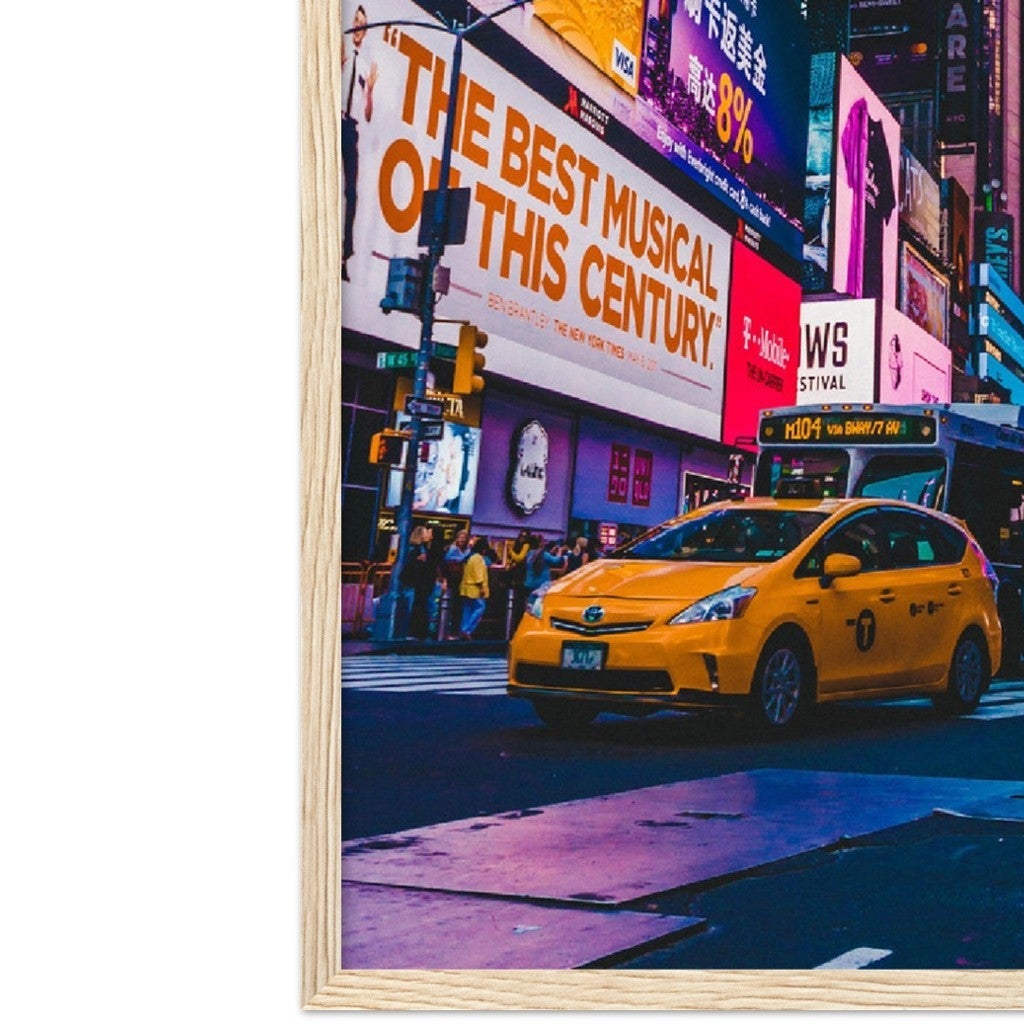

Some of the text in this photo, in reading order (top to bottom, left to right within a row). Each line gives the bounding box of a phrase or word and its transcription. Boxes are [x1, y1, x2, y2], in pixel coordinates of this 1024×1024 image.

[615, 47, 634, 78] VISA
[580, 97, 610, 125] MARRIOTT
[500, 106, 600, 227] BEST
[602, 173, 719, 303] MUSICAL
[476, 181, 568, 302] THIS
[554, 318, 569, 337] THE
[569, 326, 587, 344] NEW
[587, 334, 605, 351] YORK
[605, 340, 625, 360] TIMES
[805, 321, 848, 369] WS
[797, 374, 846, 392] STIVAL
[785, 417, 900, 440] M104 via BWAY/7 AV
